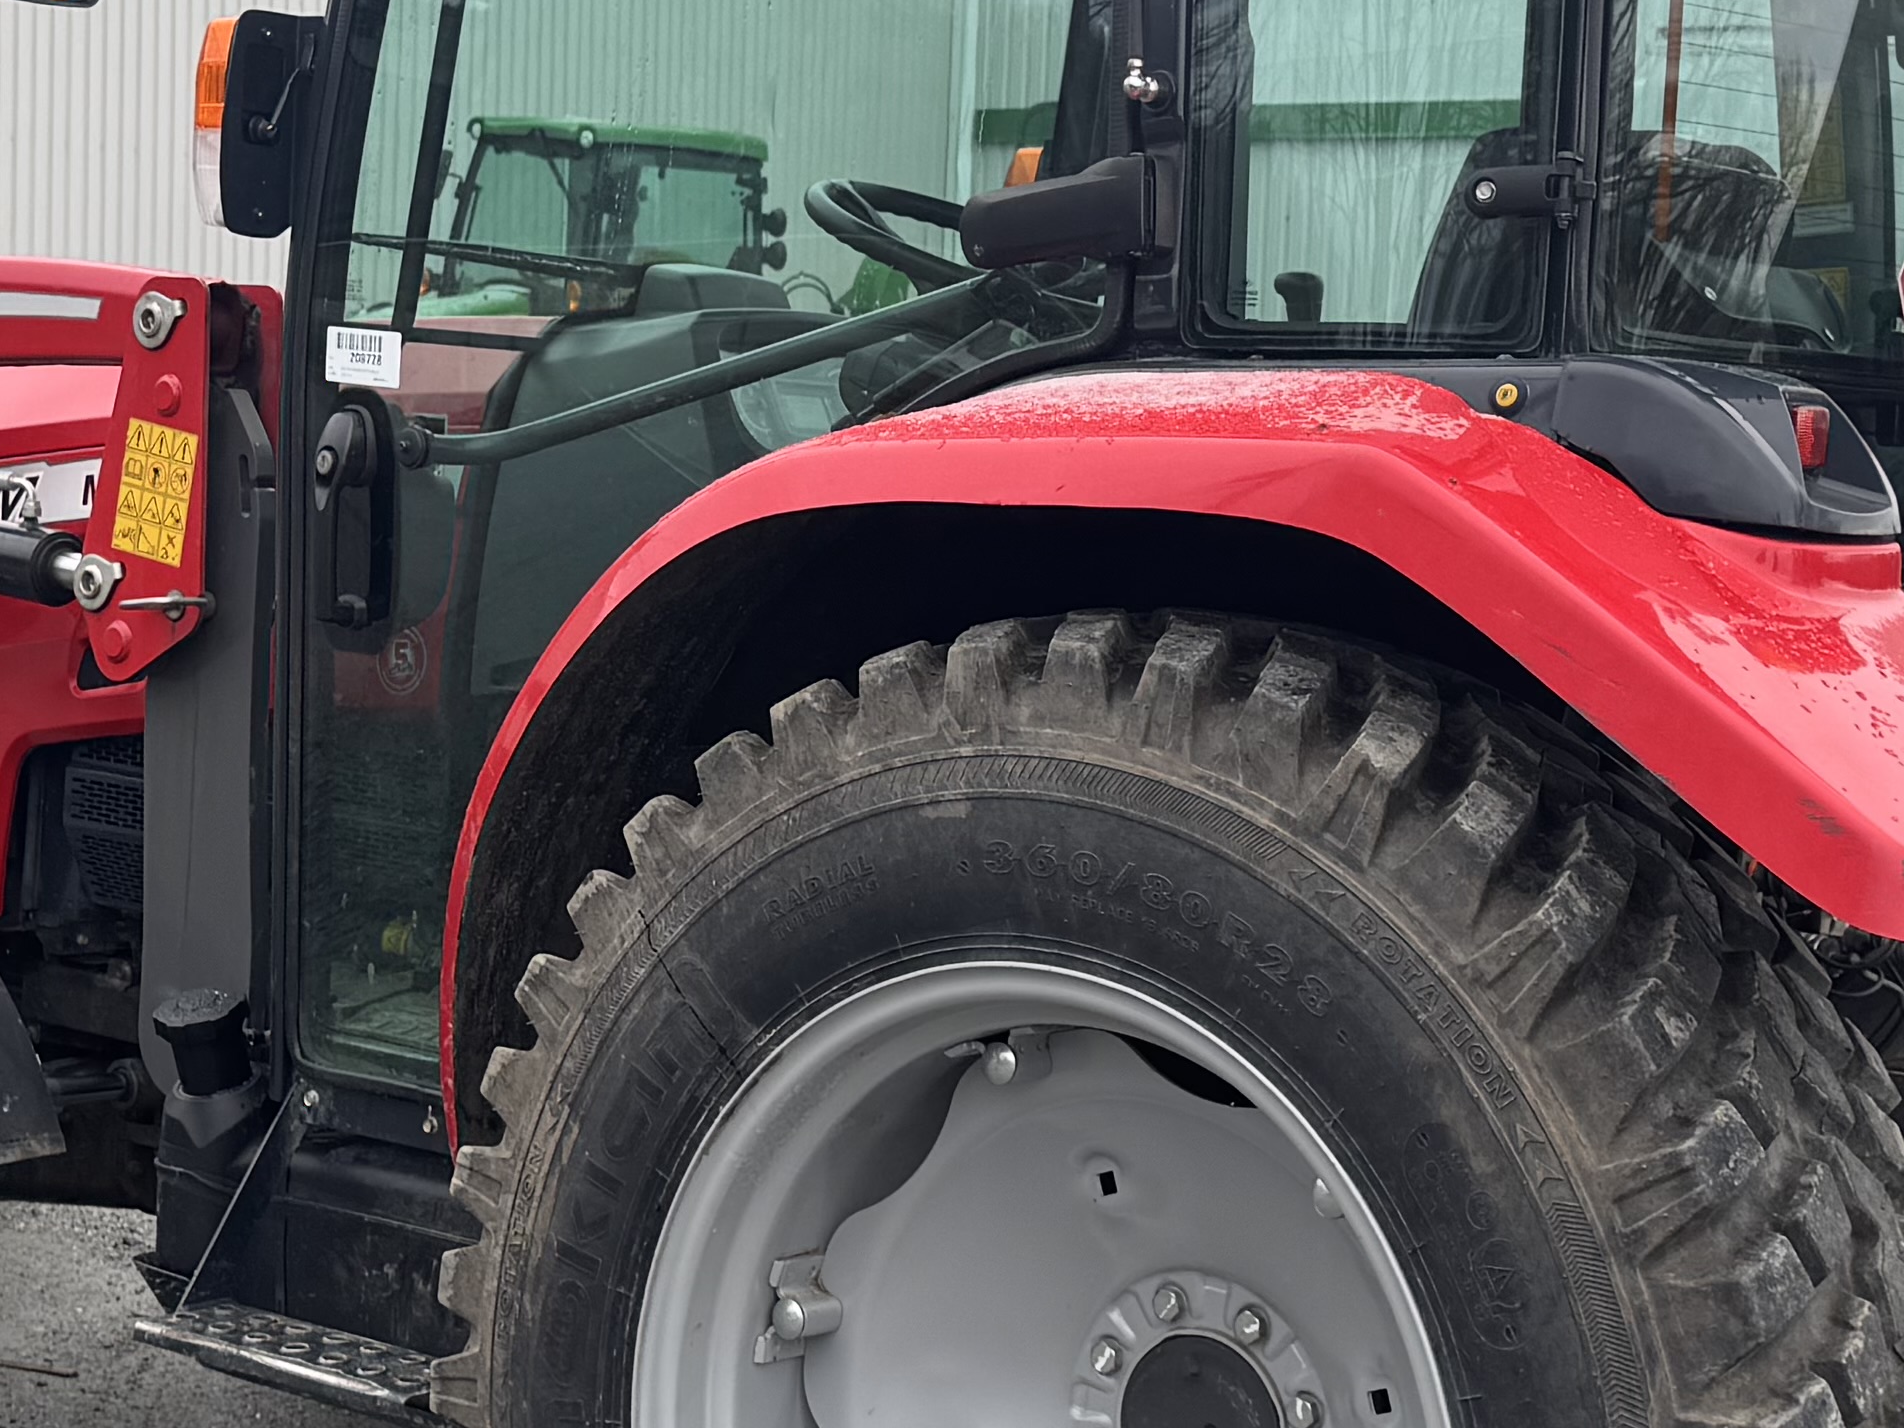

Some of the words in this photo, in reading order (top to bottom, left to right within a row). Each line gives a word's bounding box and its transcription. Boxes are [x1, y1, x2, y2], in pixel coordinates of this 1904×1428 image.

[760, 853, 876, 925] RADIAL
[1348, 910, 1517, 1111] ROTATION
[496, 1141, 547, 1348] ROTATION
